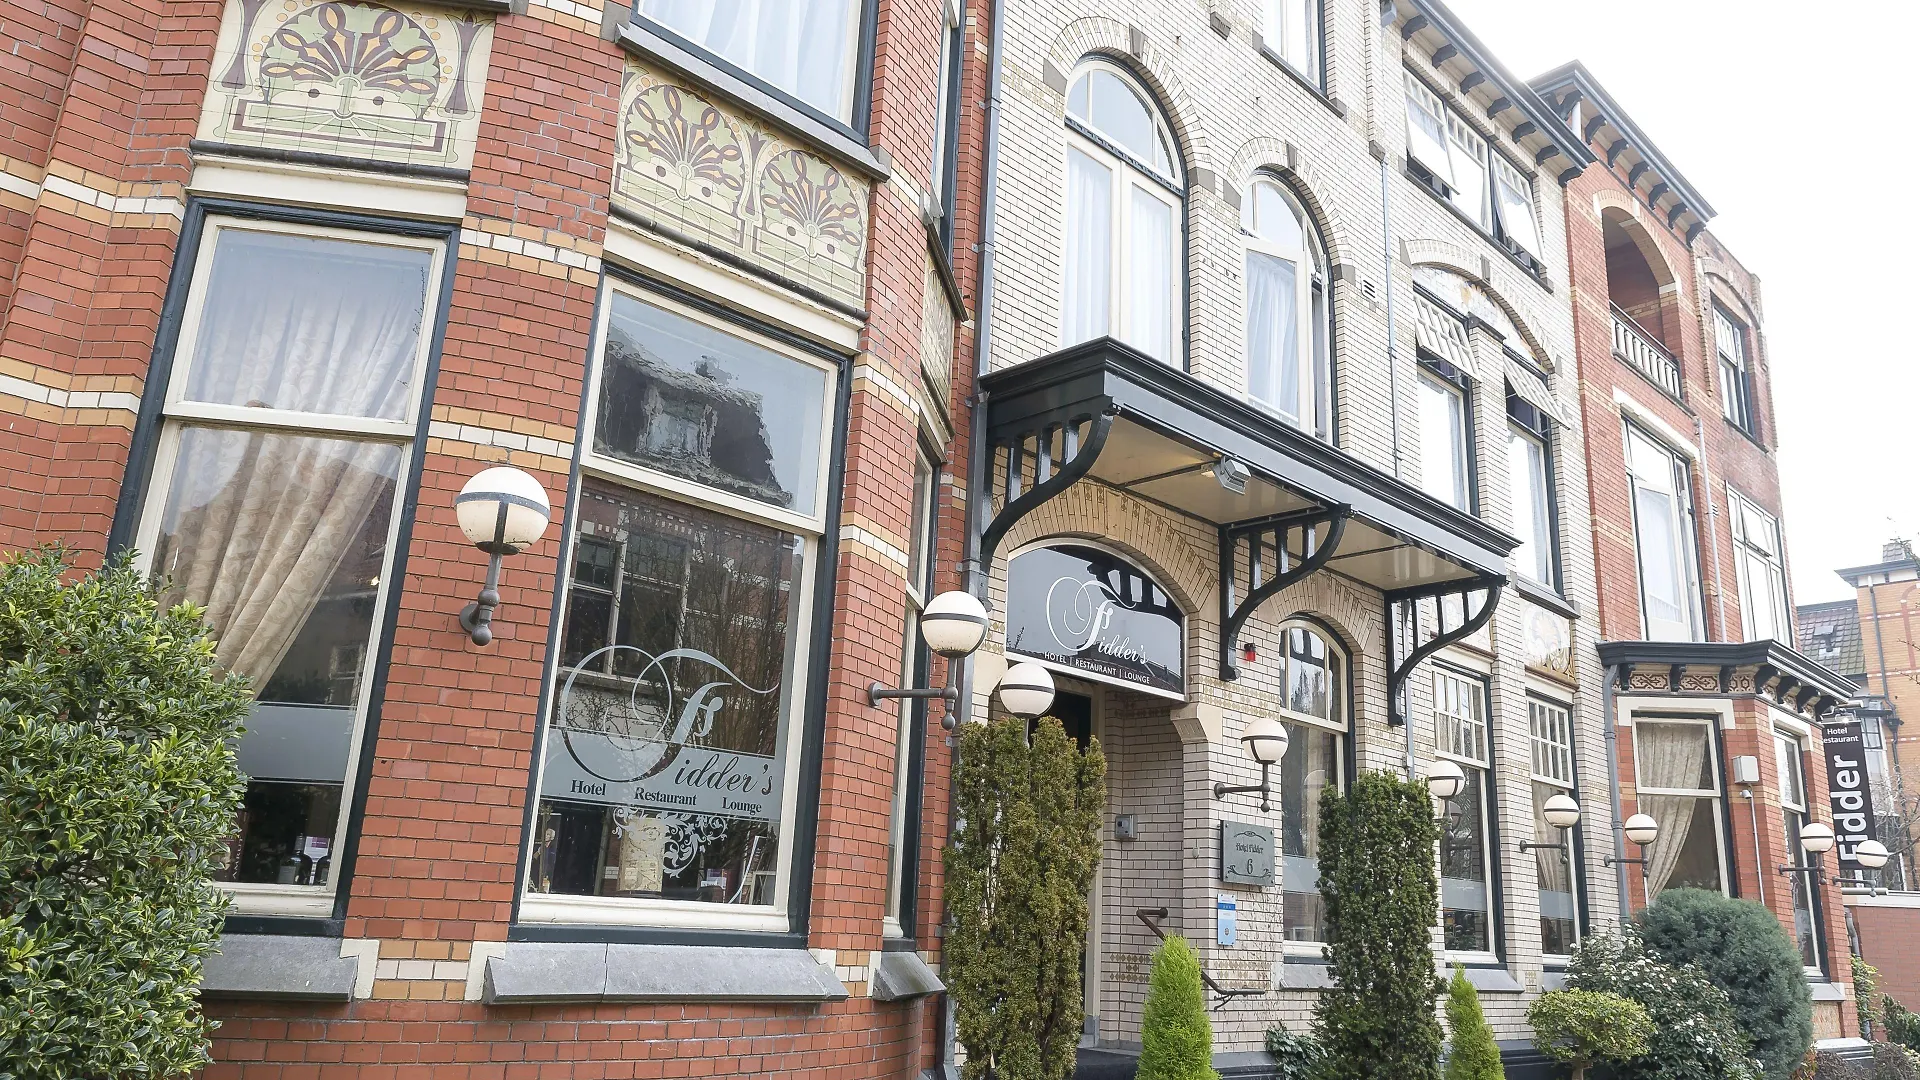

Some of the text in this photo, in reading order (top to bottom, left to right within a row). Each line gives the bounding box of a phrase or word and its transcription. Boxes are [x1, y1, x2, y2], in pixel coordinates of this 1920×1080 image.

[1046, 576, 1148, 664] Fidder's
[1044, 651, 1150, 684] HOTEL RESTAURANT LOUNGE
[561, 645, 779, 796] Fidder's
[1827, 727, 1848, 735] Hotel
[1823, 735, 1859, 743] estaurant
[570, 779, 762, 813] Hotel Restaurant Lounge
[1247, 858, 1254, 874] 6
